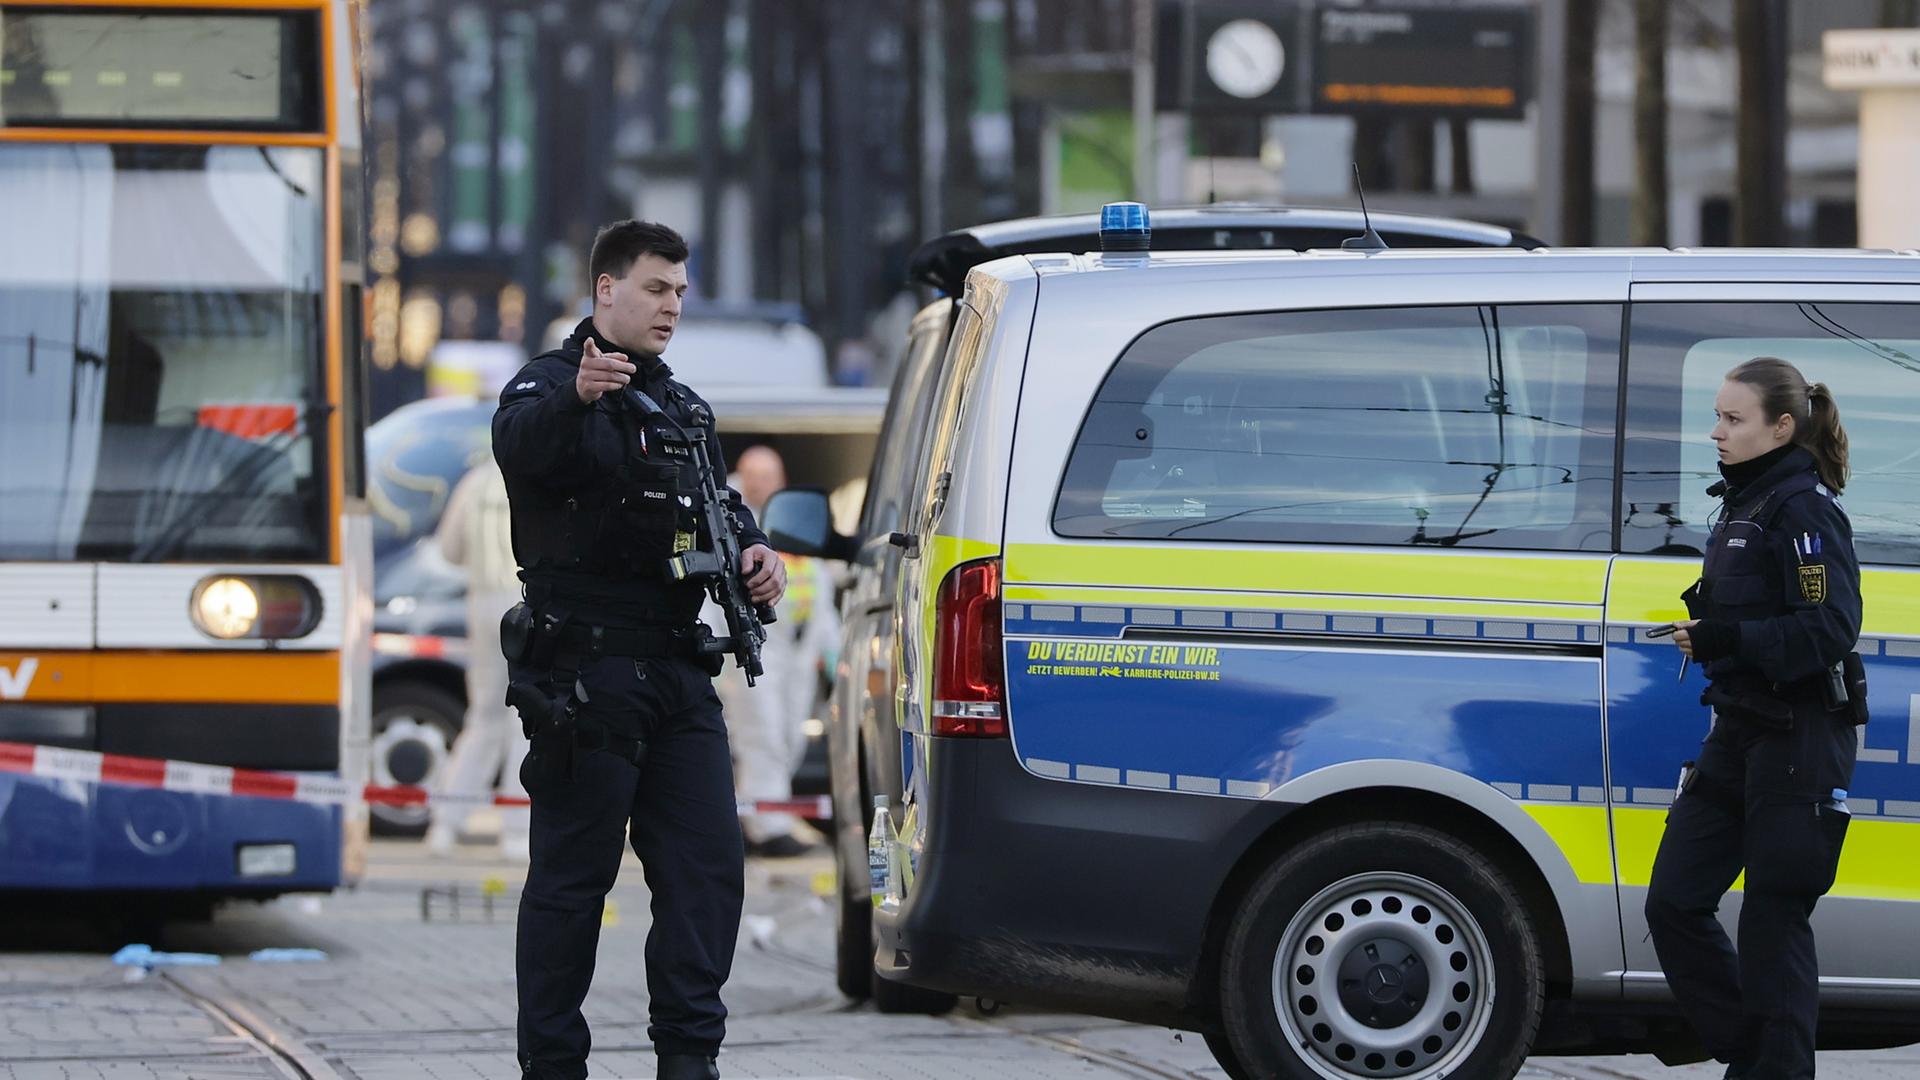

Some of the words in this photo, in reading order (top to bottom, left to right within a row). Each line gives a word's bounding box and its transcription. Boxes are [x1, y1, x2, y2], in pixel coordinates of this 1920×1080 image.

[643, 491, 667, 499] POLIZEI
[1027, 641, 1053, 660] DU
[1055, 642, 1148, 663] VERDIENST
[1150, 646, 1179, 664] EIN
[1184, 647, 1220, 666] WIR.
[1026, 664, 1052, 675] JETZT
[1053, 665, 1098, 676] BEWERBEN!
[1124, 668, 1220, 680] KARRIERE-POLIZEI-BW.DE
